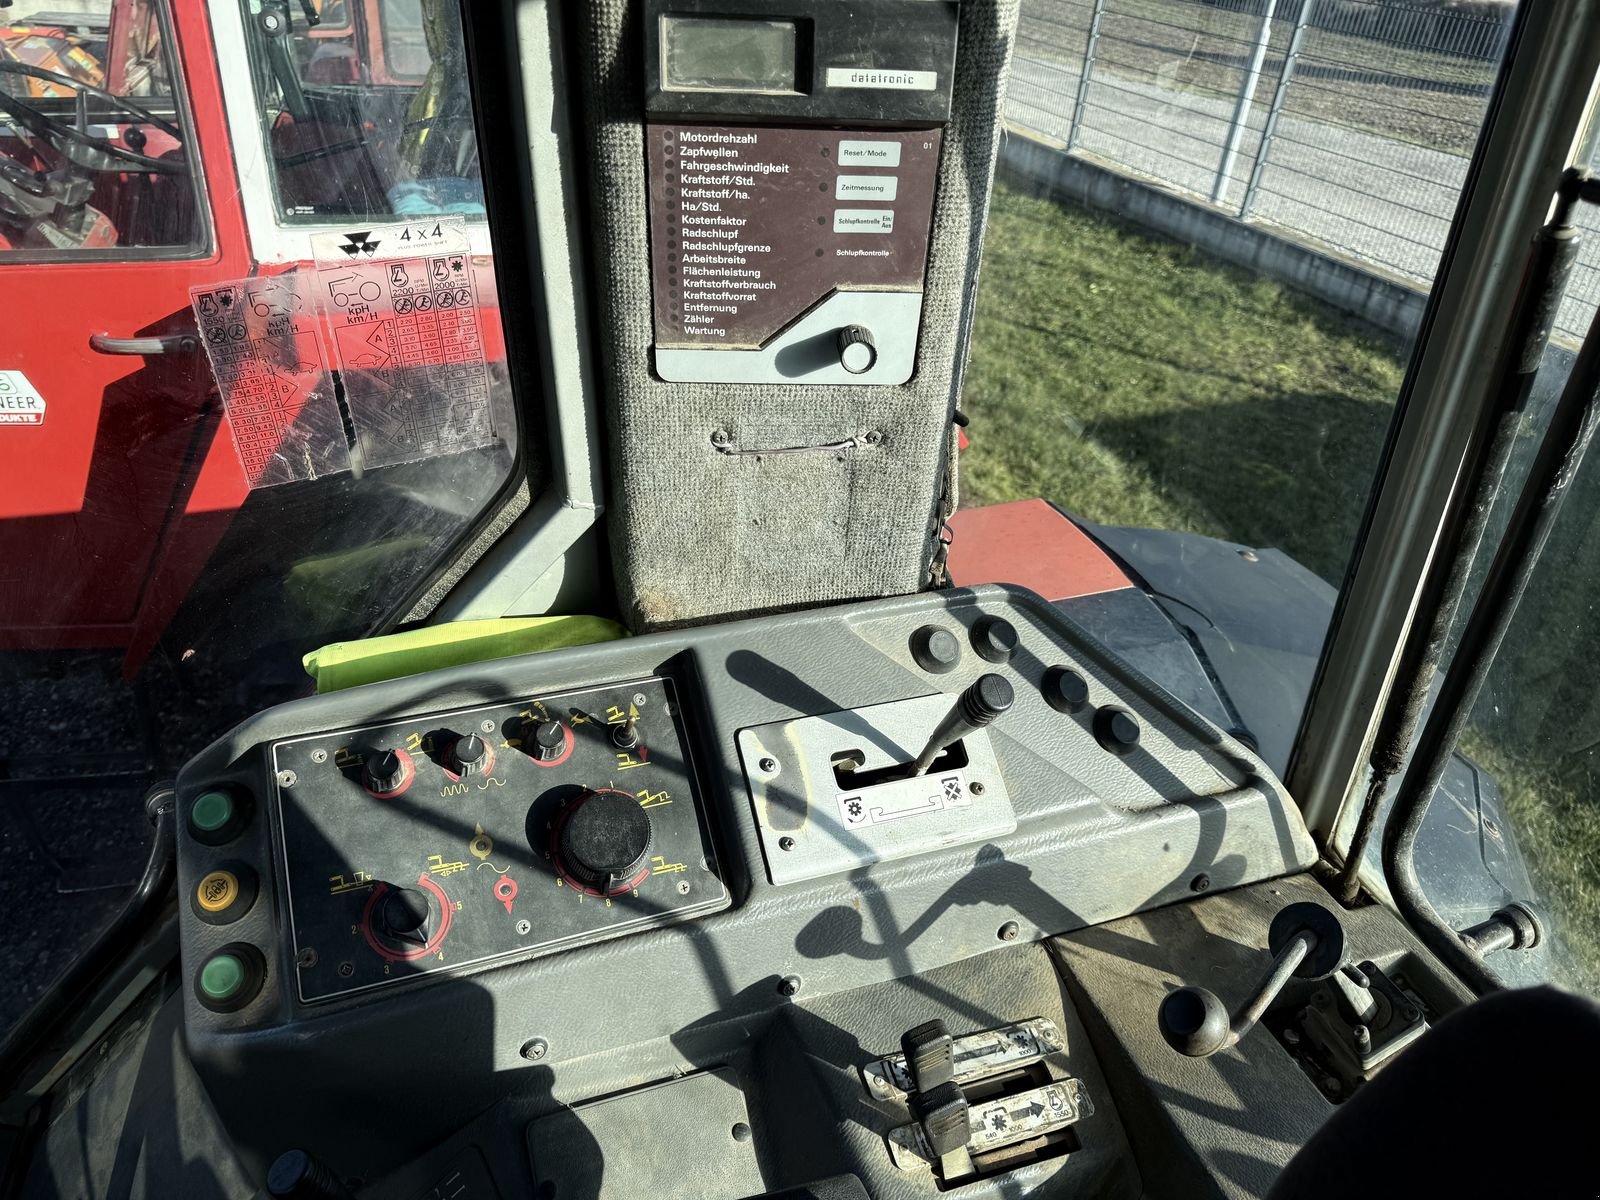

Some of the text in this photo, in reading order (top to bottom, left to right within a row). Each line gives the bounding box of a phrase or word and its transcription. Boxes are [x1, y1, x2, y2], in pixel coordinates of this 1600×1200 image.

[851, 72, 914, 85] datatronic
[679, 131, 758, 144] Motordrehzahl
[923, 142, 932, 150] 01
[679, 146, 739, 158] Zapfwellen
[843, 149, 887, 157] Reset/Mode
[680, 160, 790, 174] Fahrgeschwindigkeit
[680, 174, 756, 186] Kraftstoff/Std.
[841, 184, 884, 193] Zeitmessung
[681, 188, 751, 200] Kraftstoff/ha.
[681, 201, 722, 212] Ha/Std.
[681, 215, 747, 226] Kostenfaktor
[838, 217, 881, 225] Schlupfkontrolle
[681, 228, 739, 240] Radschlupf
[682, 241, 771, 253] Radschlupfgrenze
[836, 249, 890, 258] Schlupfkontrolle
[682, 254, 747, 265] Arbeitsbreite
[683, 266, 761, 279] Flächenleistung
[434, 281, 455, 290] 2000
[683, 278, 777, 290] Kraftstoffverbrauch
[392, 287, 414, 297] 2200
[683, 291, 757, 302] Kraftstoffvorrat
[348, 305, 370, 316] kpH
[683, 302, 738, 314] Entfernung
[203, 316, 225, 325] 1550
[347, 312, 378, 325] km/H
[683, 314, 715, 324] Zähler
[266, 324, 299, 336] km/H
[387, 329, 393, 337] 2
[683, 326, 726, 337] Wartung
[375, 334, 382, 342] A
[246, 386, 263, 395] 4.70
[281, 384, 290, 393] B
[234, 418, 252, 426] 6.30
[254, 415, 271, 423] 7.95
[236, 426, 254, 434] 7.50
[256, 423, 273, 431] 9.45
[259, 431, 275, 439] 11.0
[241, 442, 258, 450] 10.4
[244, 449, 261, 457] 12.6
[246, 456, 263, 464] 15.0
[609, 780, 614, 789] 1
[556, 878, 563, 887] 6
[632, 889, 639, 898] 9
[578, 894, 584, 904] 7
[605, 898, 612, 907] 8
[456, 901, 463, 910] 5
[351, 925, 357, 934] 2
[438, 951, 444, 961] 4
[1053, 1109, 1069, 1118] 1550
[985, 1131, 997, 1140] 540
